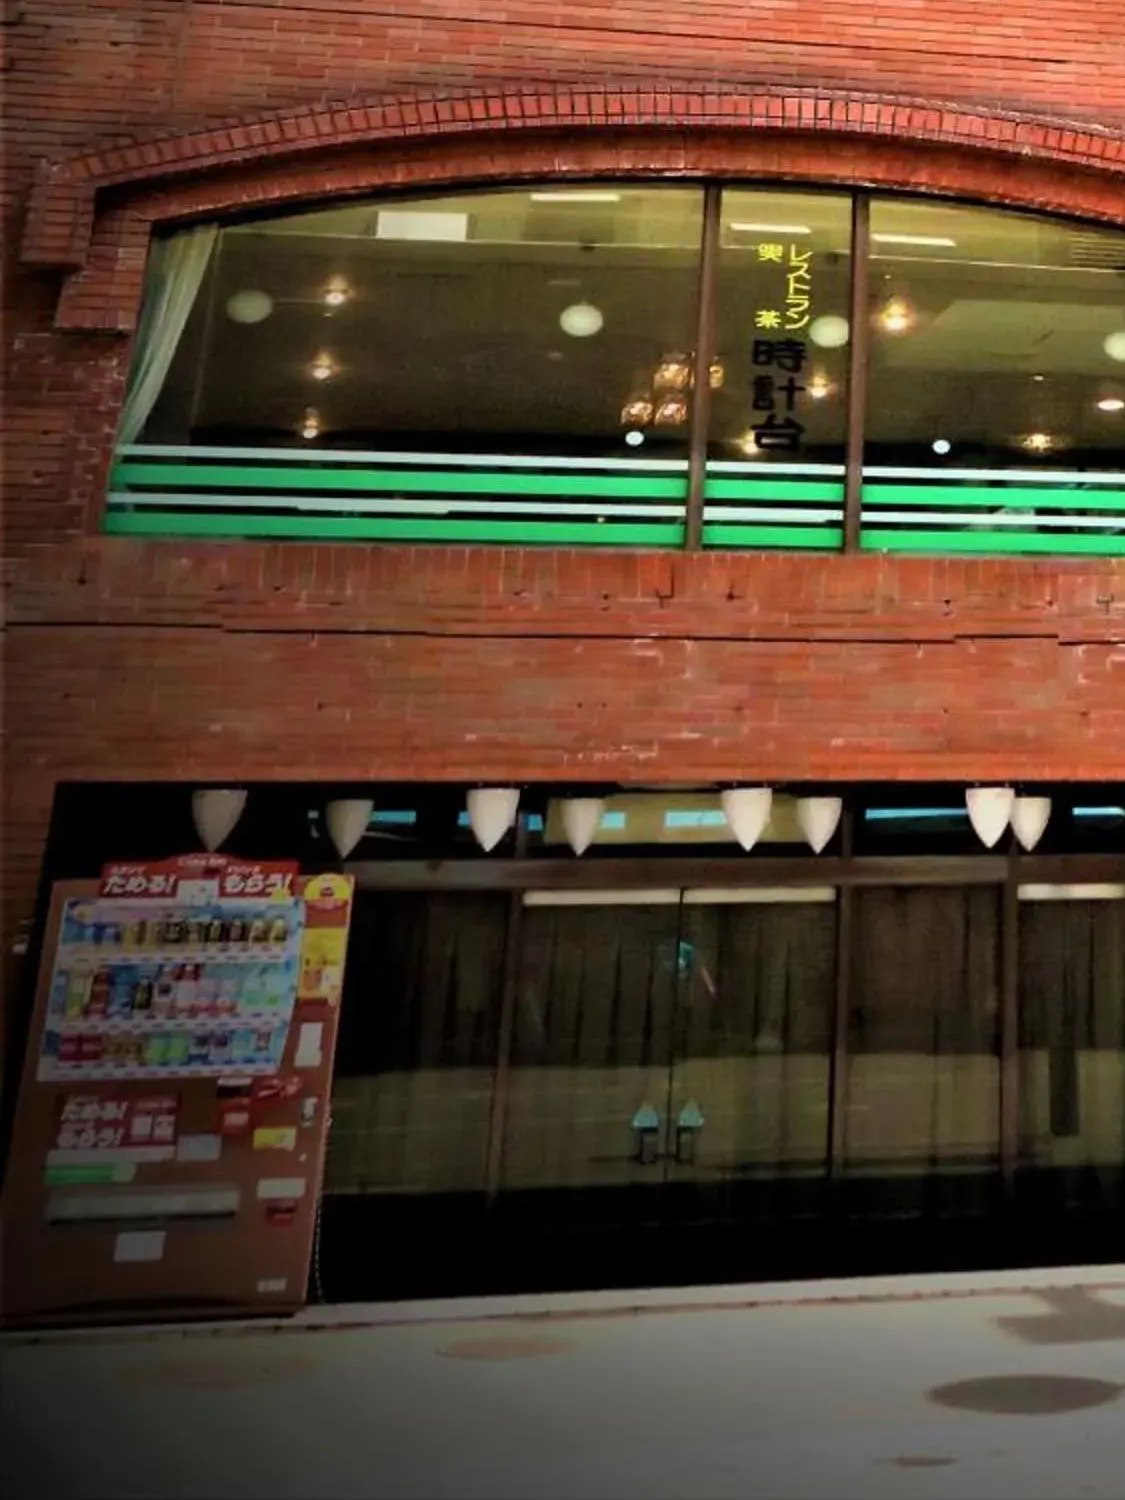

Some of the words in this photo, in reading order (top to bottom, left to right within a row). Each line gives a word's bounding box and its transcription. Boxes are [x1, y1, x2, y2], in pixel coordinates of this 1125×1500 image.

[784, 243, 814, 330] レストラン
[752, 339, 806, 449] 時計台
